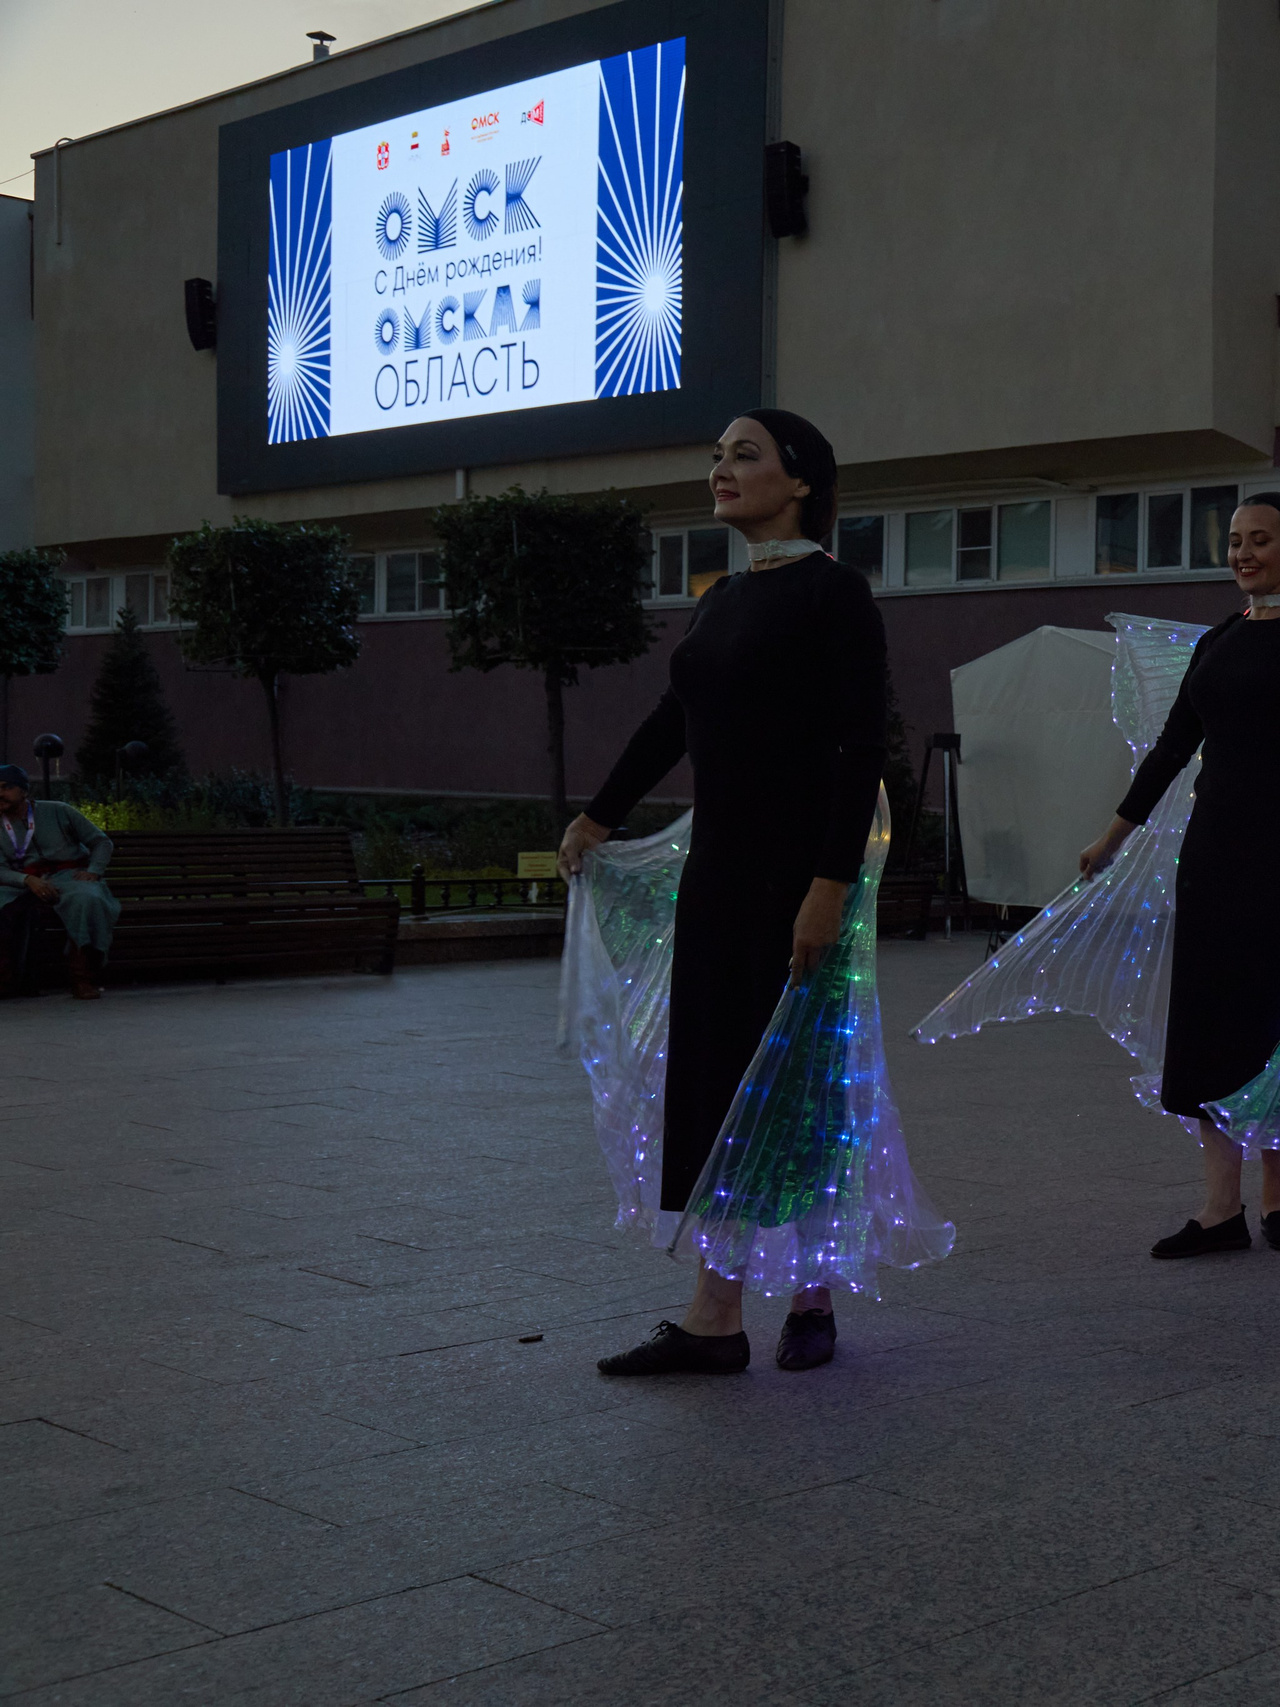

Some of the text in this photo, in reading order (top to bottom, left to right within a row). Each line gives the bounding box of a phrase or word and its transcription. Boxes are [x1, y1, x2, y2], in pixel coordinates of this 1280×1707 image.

[471, 111, 499, 130] ОМСК
[376, 156, 542, 261] ОМСК
[393, 262, 439, 297] Днём
[446, 236, 542, 287] рождения!
[375, 278, 541, 357] ОМСКАЯ
[374, 341, 540, 411] ОБЛАСТЬ
